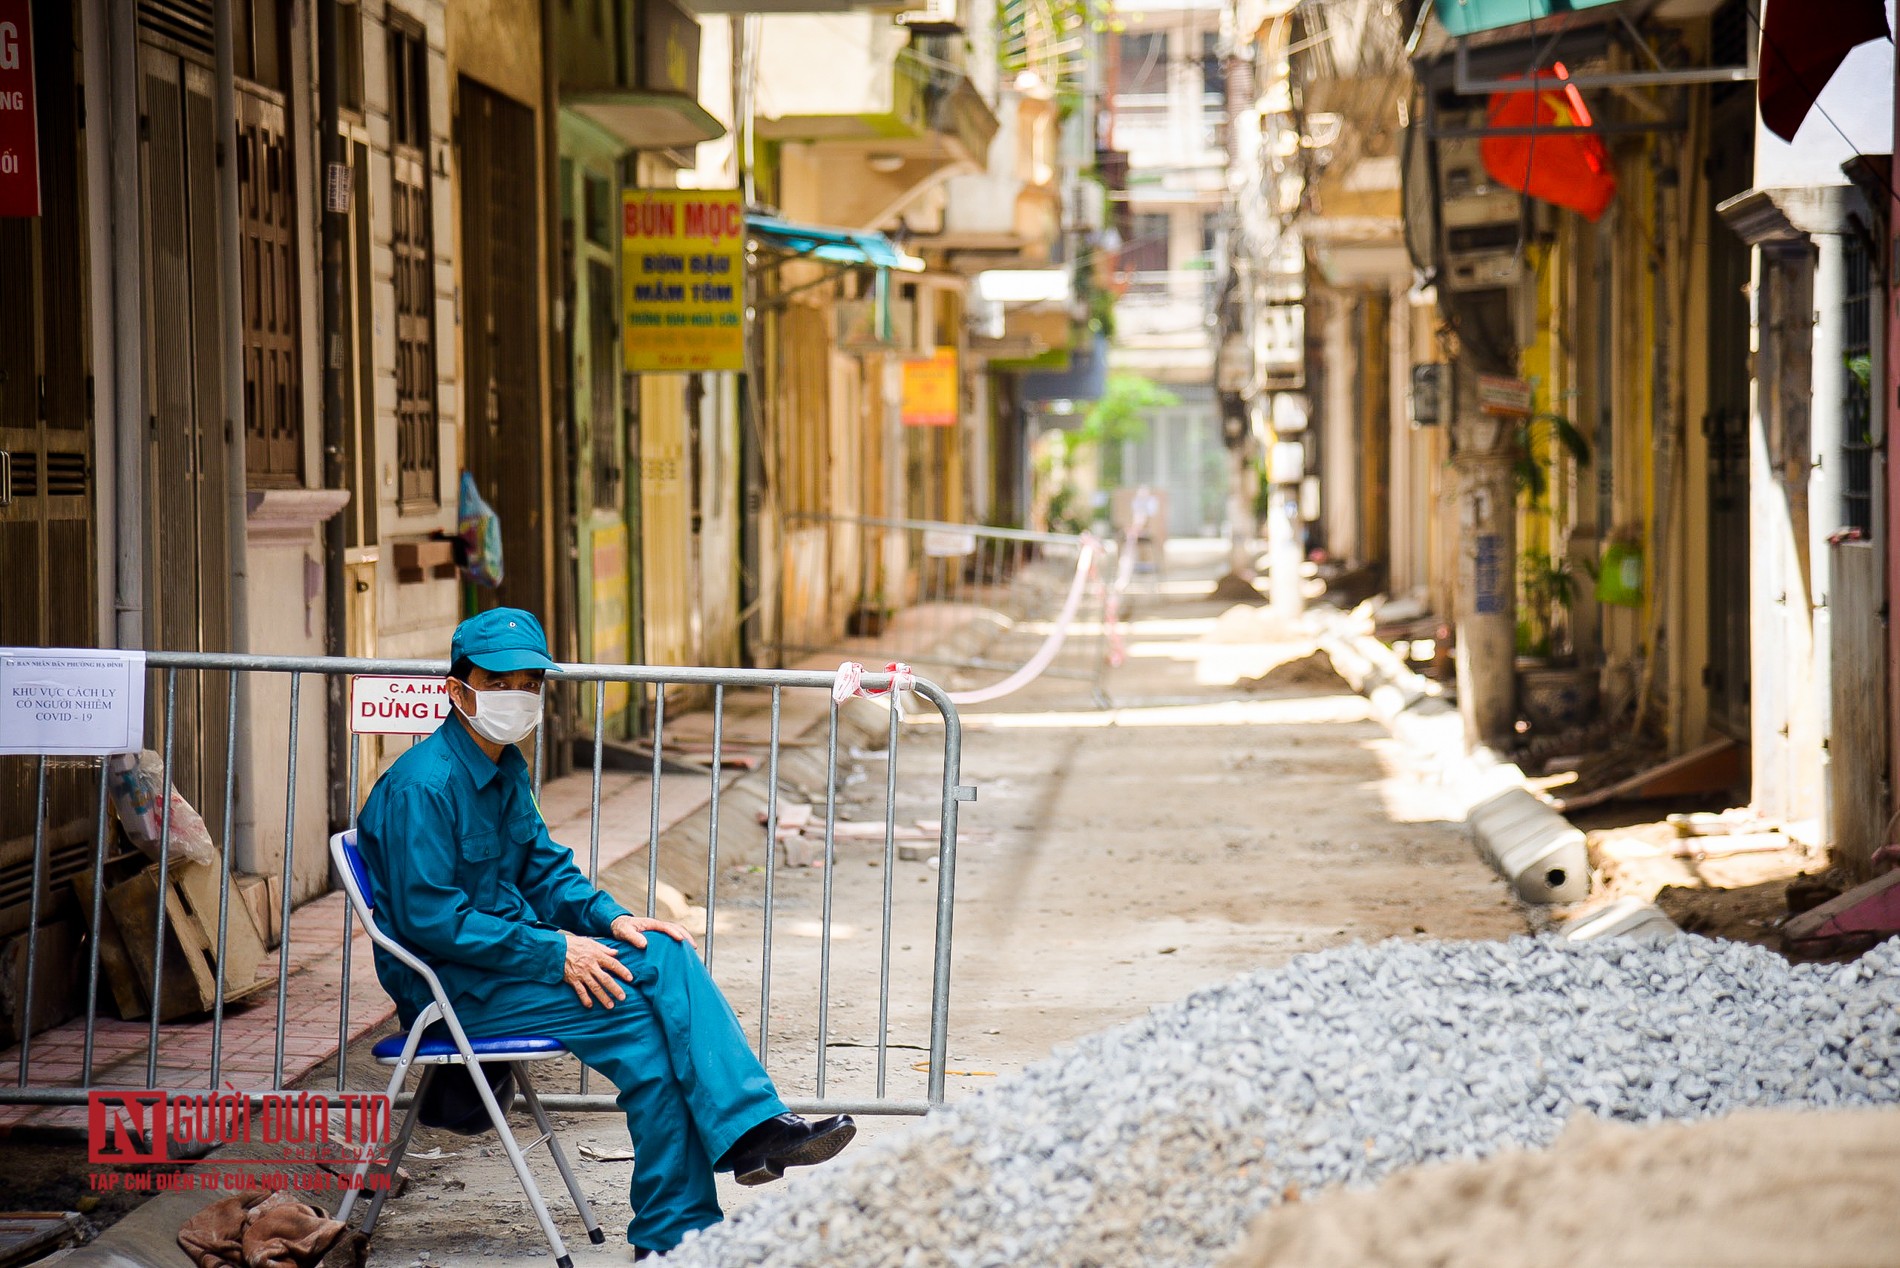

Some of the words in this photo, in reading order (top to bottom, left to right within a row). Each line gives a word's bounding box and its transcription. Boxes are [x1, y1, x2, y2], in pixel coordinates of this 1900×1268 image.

[624, 194, 675, 238] BÚN
[684, 202, 741, 246] MỌC
[12, 688, 37, 697] KHU
[40, 688, 64, 699] VỰC
[67, 686, 98, 698] CÁCH
[101, 688, 117, 698] LY
[16, 698, 33, 709] CÓ
[35, 699, 72, 710] NGƯỜI
[75, 699, 112, 710] NHIỄM
[361, 697, 429, 719] DỪNG
[35, 713, 72, 722] COVID
[82, 713, 93, 722] 19
